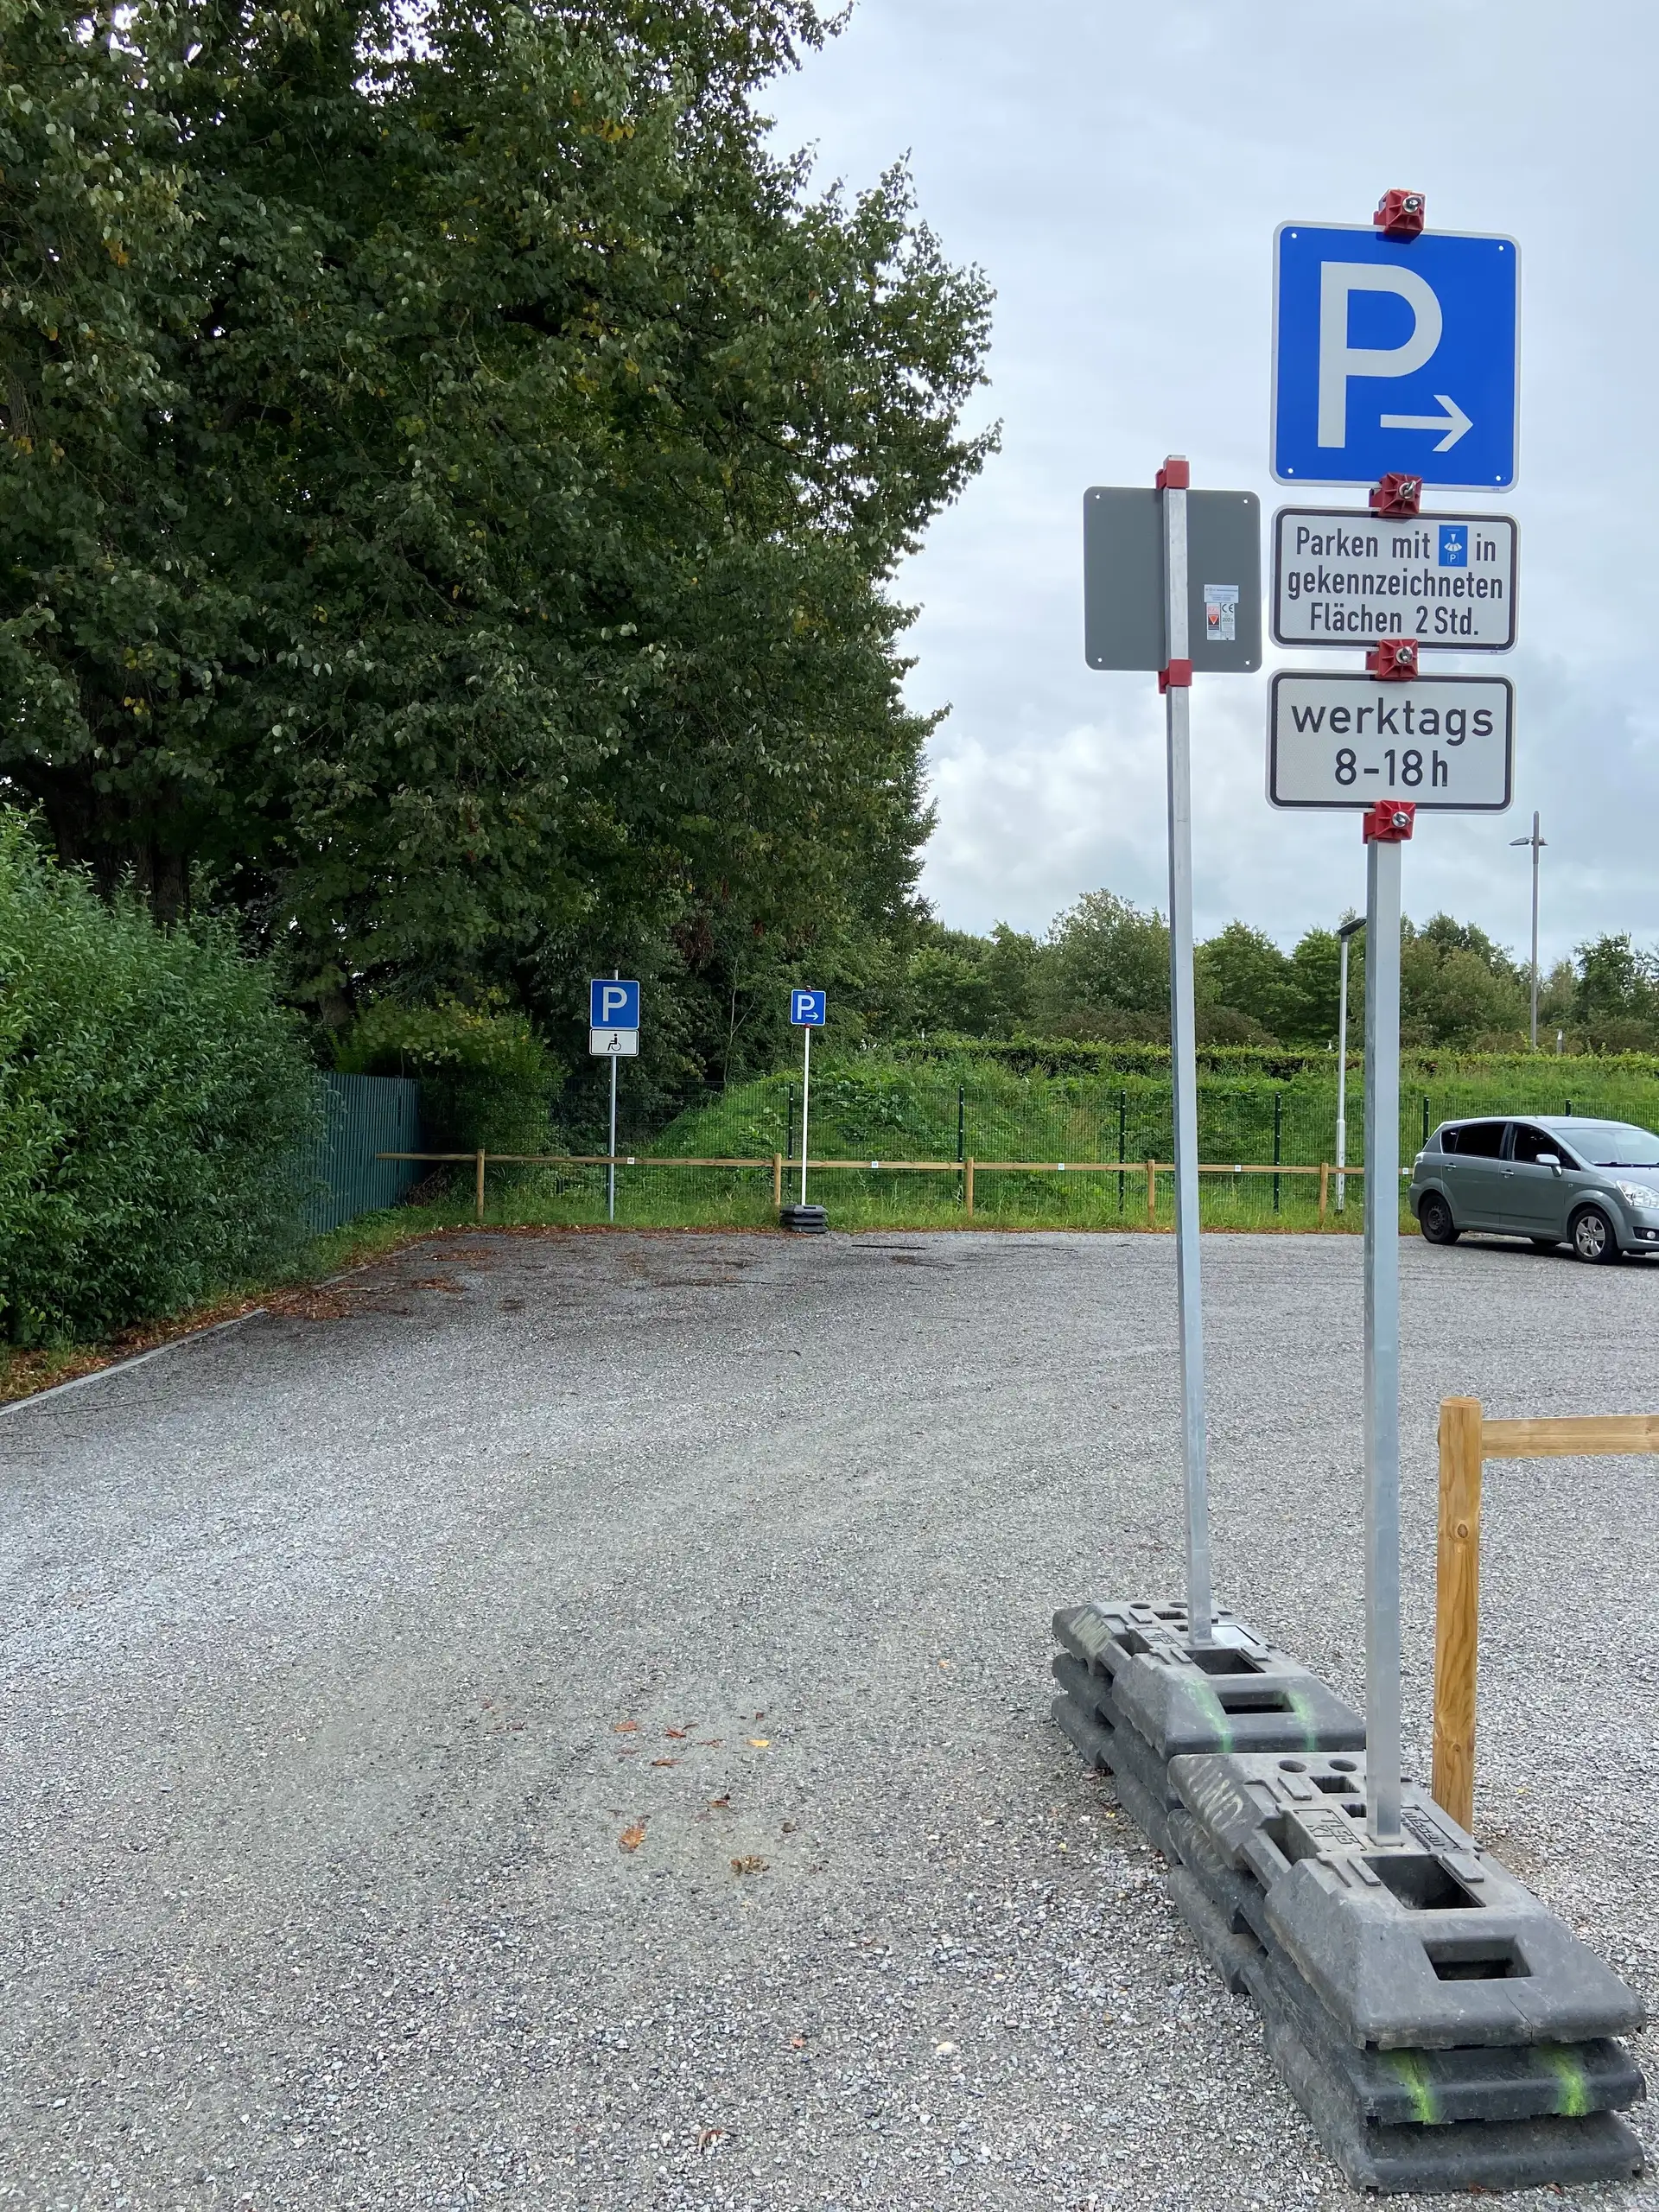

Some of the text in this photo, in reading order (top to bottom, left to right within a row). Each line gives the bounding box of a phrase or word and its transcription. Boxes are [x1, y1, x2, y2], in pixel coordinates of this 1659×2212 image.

[1318, 261, 1442, 448] P
[1296, 526, 1378, 557] Parken
[1392, 531, 1430, 559] mit
[1476, 533, 1496, 561] in
[1287, 565, 1503, 600] gekennzeichneten
[1310, 602, 1402, 633] Flächen
[1291, 697, 1493, 746] werktags
[602, 987, 627, 1021] P
[797, 995, 815, 1020] P
